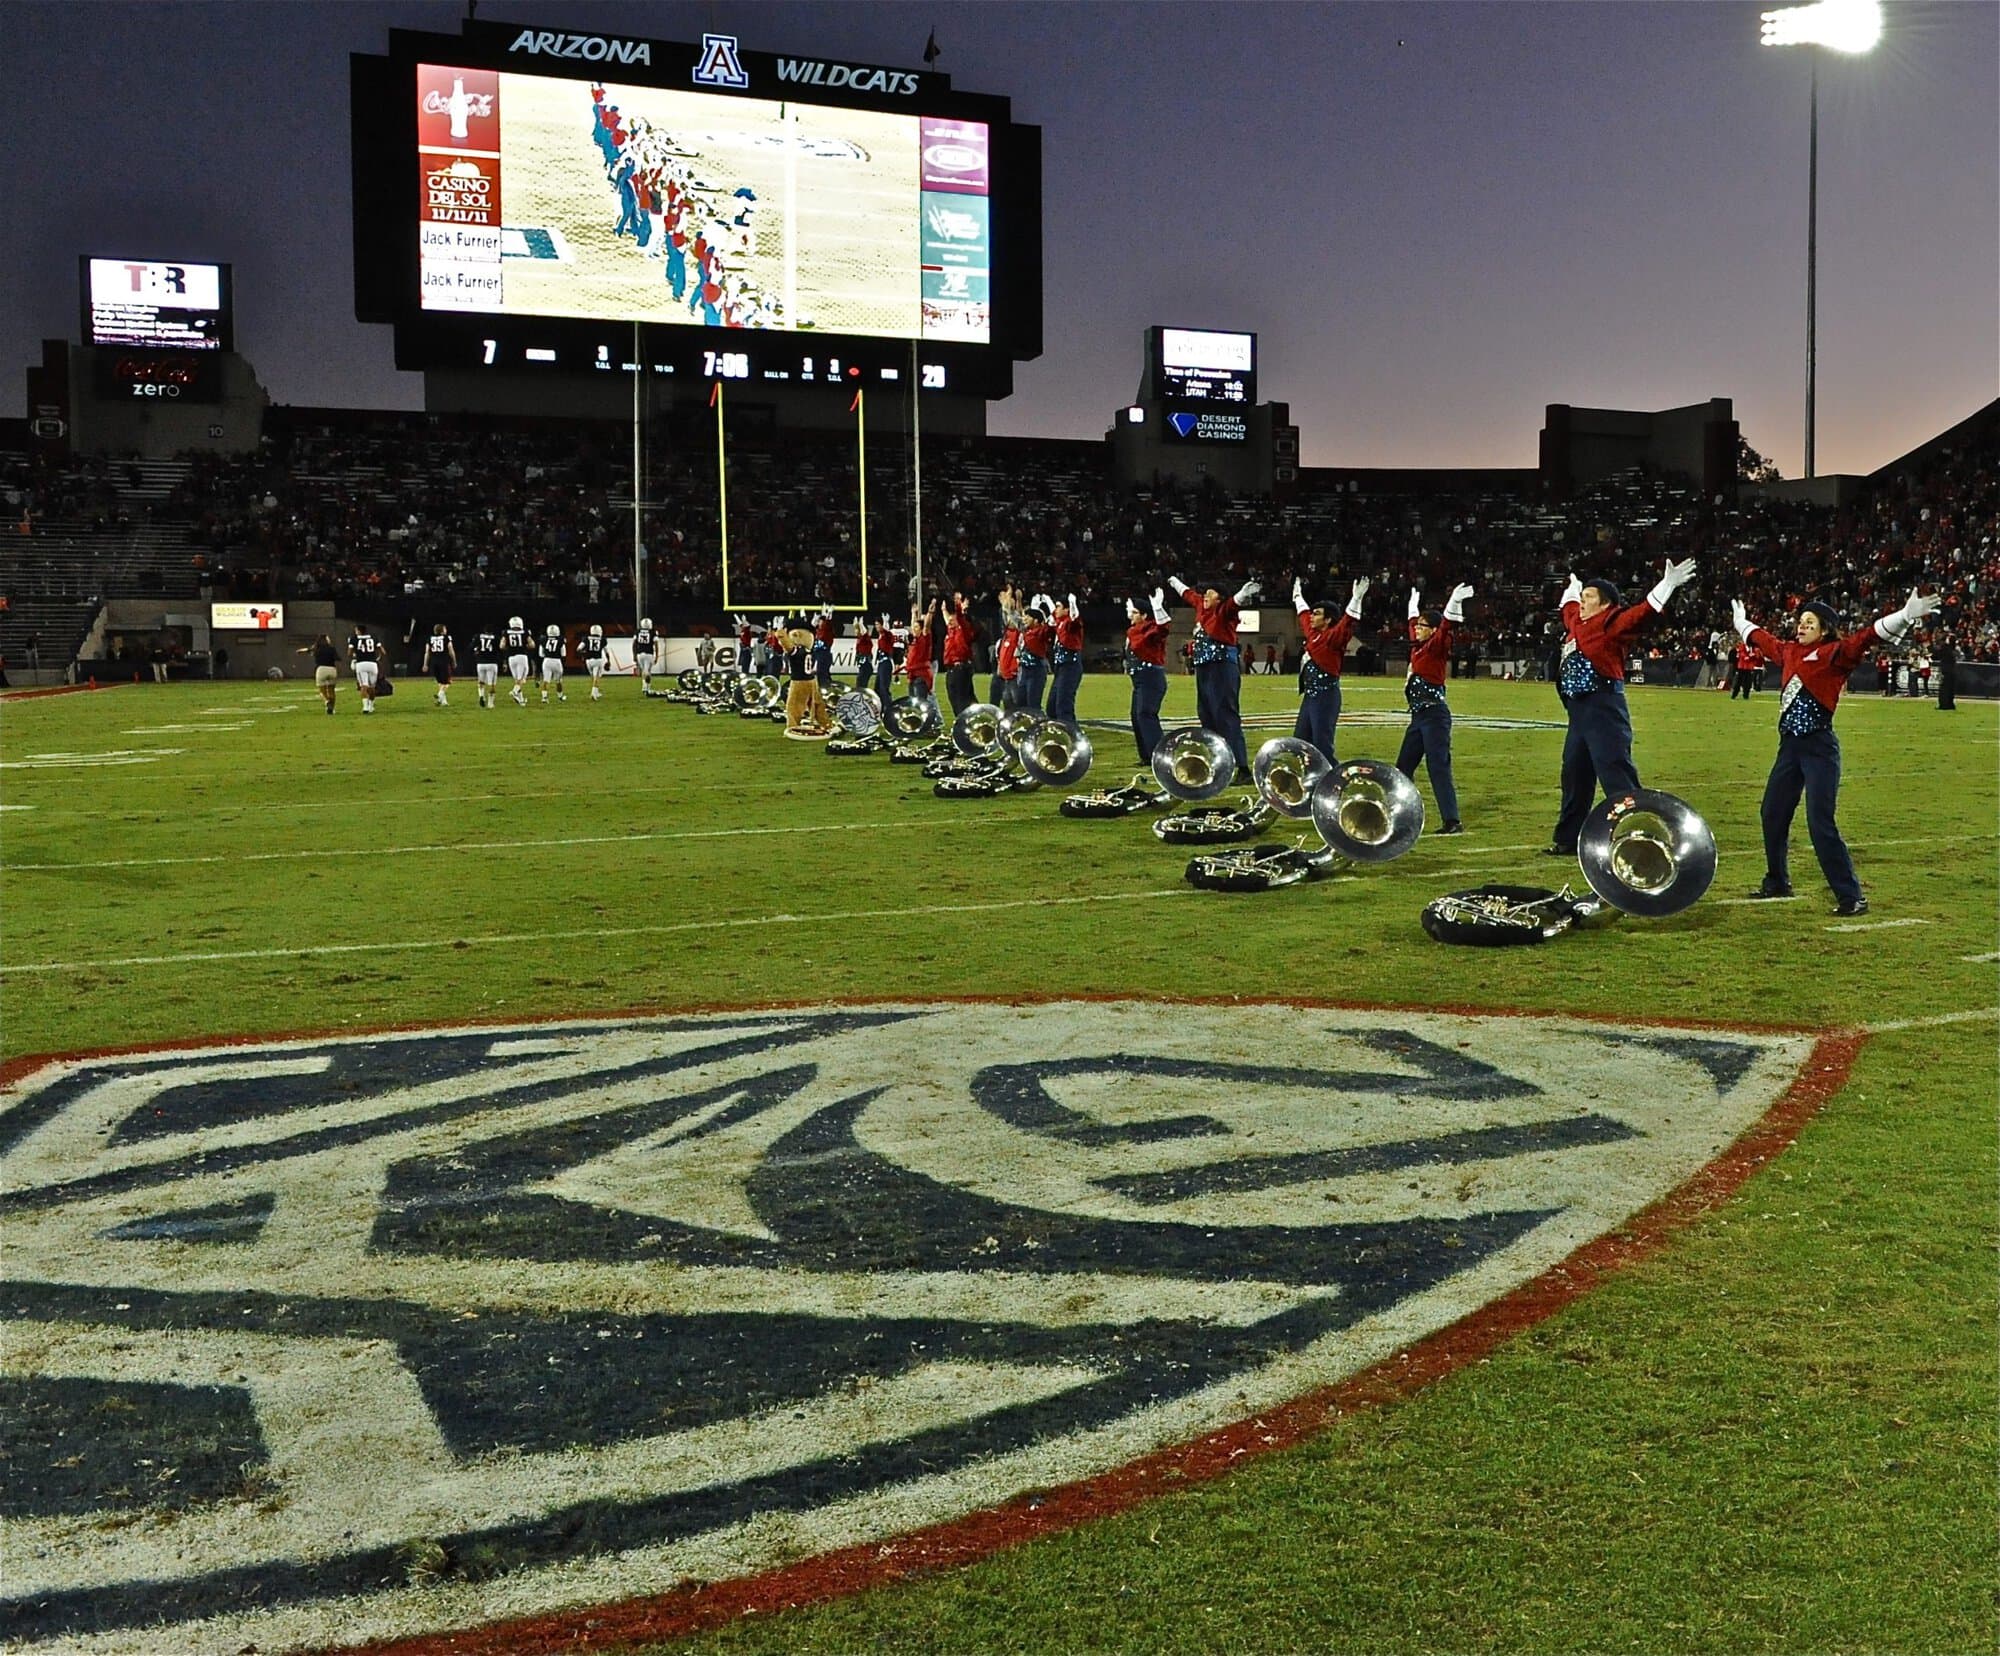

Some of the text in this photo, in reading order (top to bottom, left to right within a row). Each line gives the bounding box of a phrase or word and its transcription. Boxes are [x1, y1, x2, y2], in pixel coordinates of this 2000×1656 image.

[508, 29, 651, 66] ARIZONA
[692, 33, 748, 89] A
[777, 58, 920, 96] WILDCATS
[428, 176, 490, 193] CASINO
[428, 190, 491, 207] DEL SOL
[432, 208, 488, 223] 11/11/11
[423, 231, 498, 248] Jack Furrier
[424, 272, 498, 289] Jack Furrier
[483, 340, 496, 364] 7
[133, 384, 180, 396] zero
[1196, 422, 1246, 432] DIAMOND
[1201, 415, 1241, 424] DESERT
[1197, 431, 1245, 440] CASINOS
[480, 638, 492, 652] 14
[509, 634, 522, 647] 61
